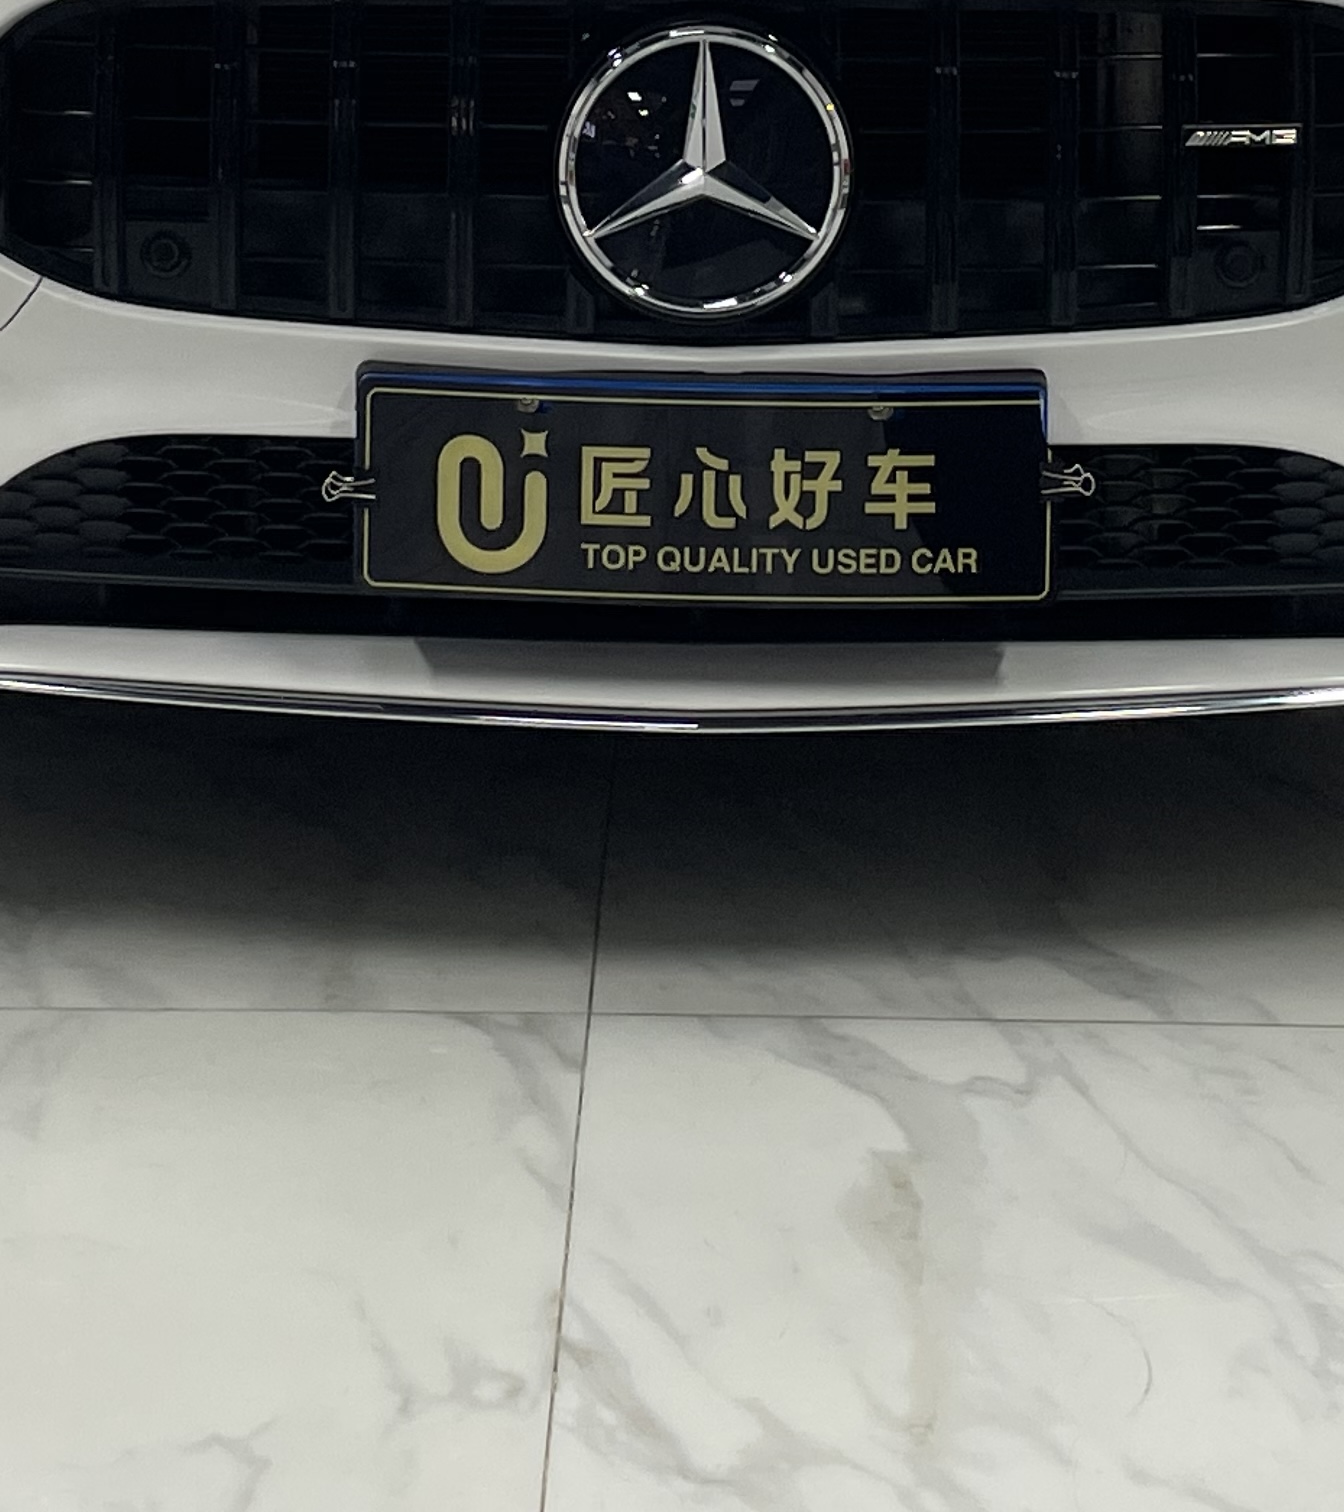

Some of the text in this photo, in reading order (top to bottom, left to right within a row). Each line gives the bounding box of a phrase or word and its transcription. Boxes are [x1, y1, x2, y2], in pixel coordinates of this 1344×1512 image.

[580, 446, 936, 531] 匠心好车
[581, 542, 978, 576] TOP QUALITY USED CAR
